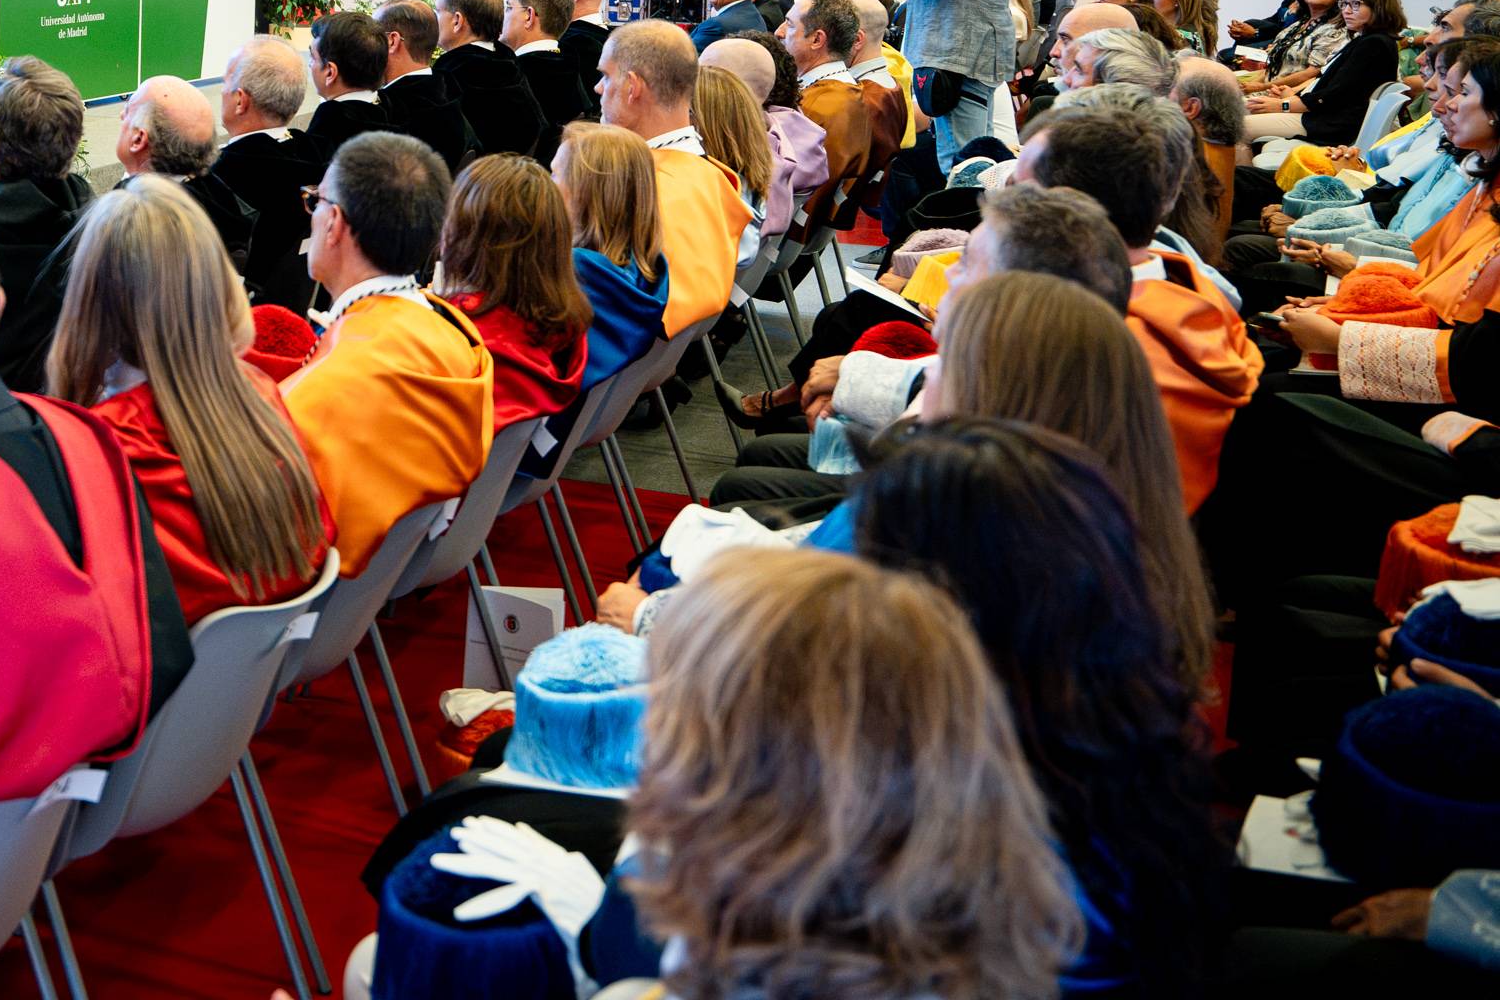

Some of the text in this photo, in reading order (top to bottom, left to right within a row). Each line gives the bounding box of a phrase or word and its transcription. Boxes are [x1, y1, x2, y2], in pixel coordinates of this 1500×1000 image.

[40, 12, 105, 27] Universidad Autónoma
[58, 26, 87, 39] de Madrid
